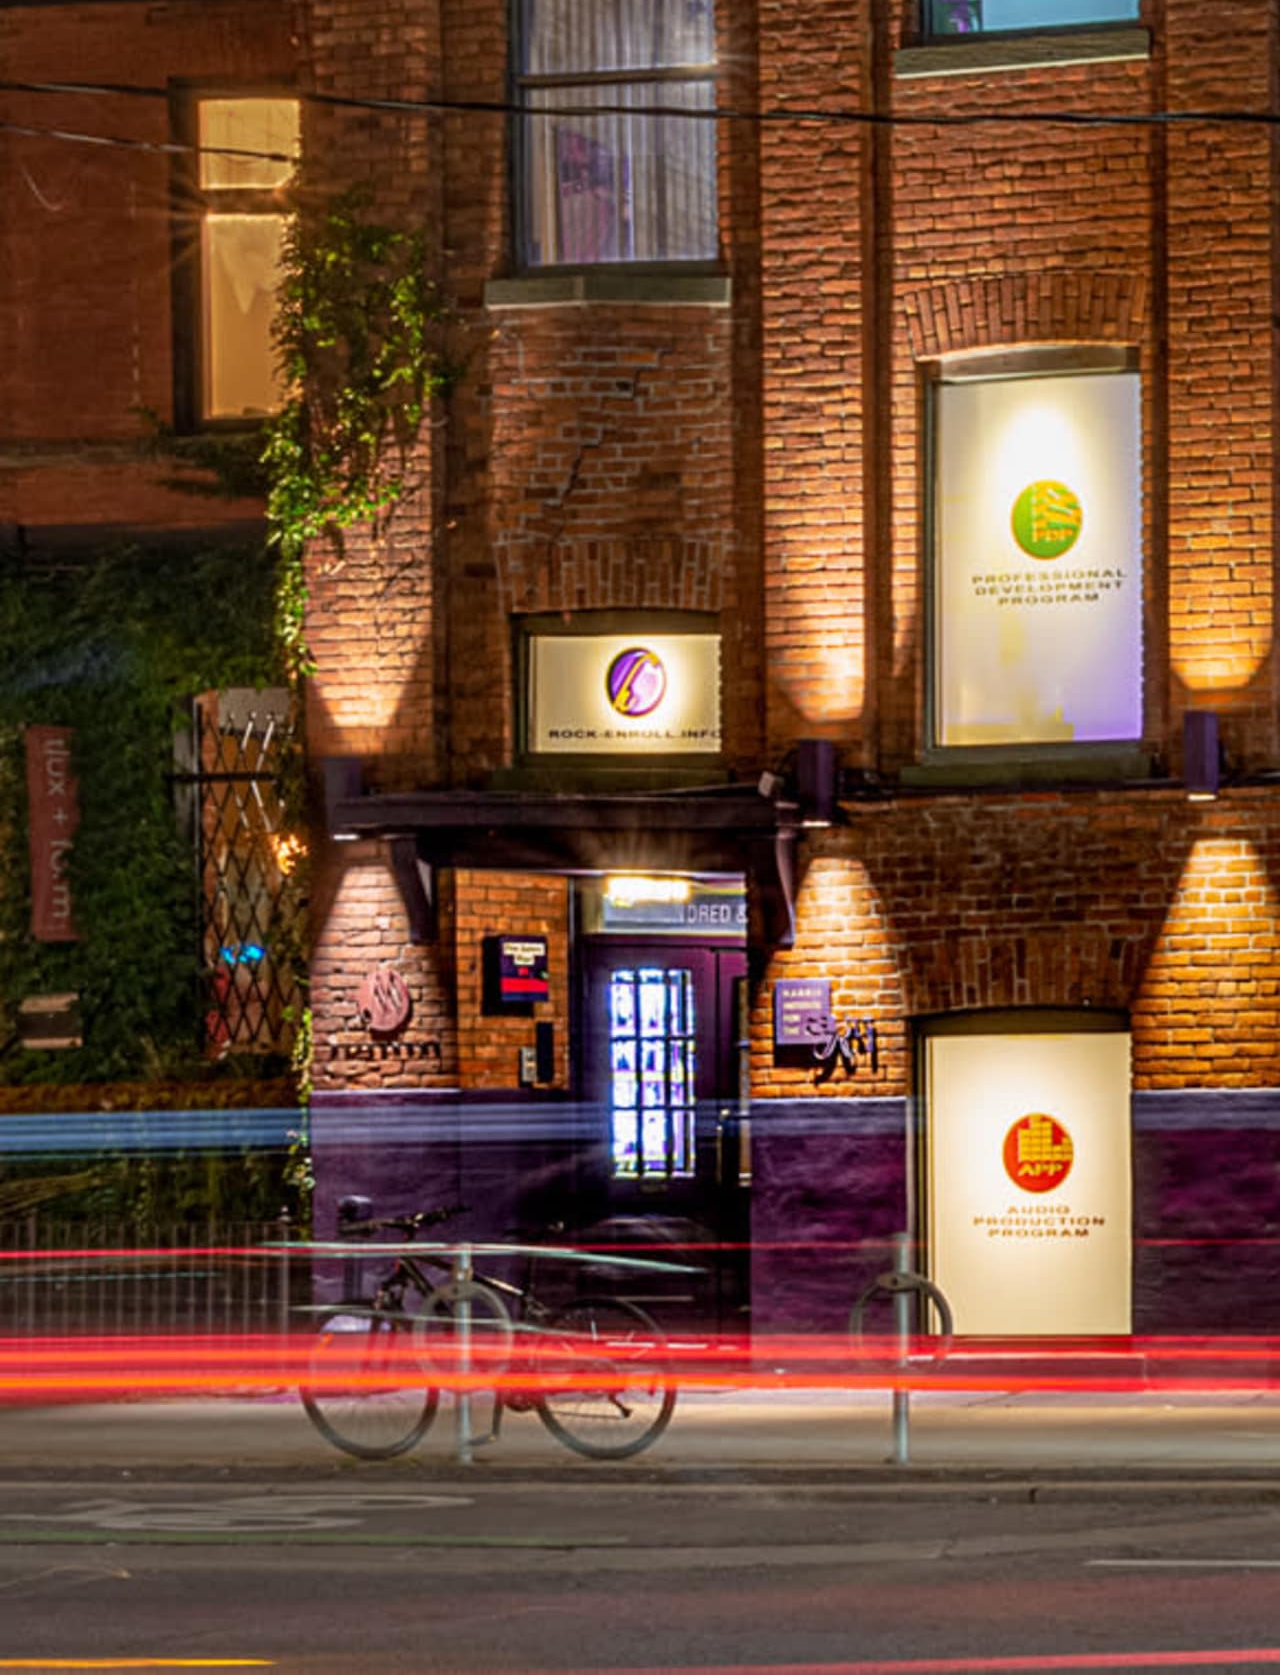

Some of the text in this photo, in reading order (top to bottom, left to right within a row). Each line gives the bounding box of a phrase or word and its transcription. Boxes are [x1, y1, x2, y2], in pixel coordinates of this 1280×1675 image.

[971, 568, 1127, 584] PROFESSIONAL
[975, 579, 1123, 595] DEVELOPMENT
[997, 593, 1100, 605] PROGRAM
[1018, 1162, 1064, 1176] APP
[1007, 1205, 1071, 1215] AUDIO
[973, 1216, 1106, 1227] PRODUCTION
[987, 1227, 1090, 1238] PROGRAM
